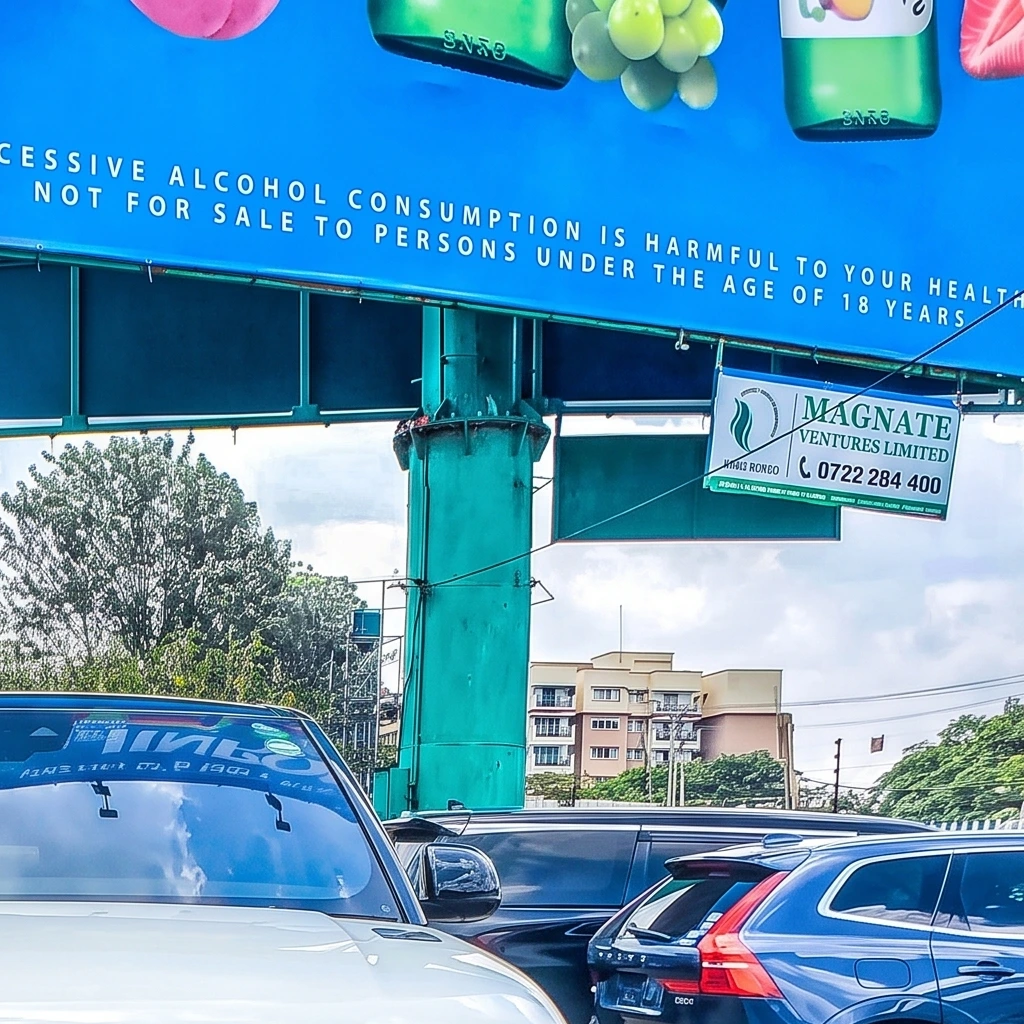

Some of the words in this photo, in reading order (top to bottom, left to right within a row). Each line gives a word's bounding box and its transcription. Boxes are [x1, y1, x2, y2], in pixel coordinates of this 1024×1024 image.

[169, 165, 326, 205] ALCOHOL
[348, 189, 580, 241] CONSUMPTION
[601, 225, 625, 248] IS
[646, 232, 779, 271] HARMFUL
[796, 256, 827, 279] TO
[844, 264, 911, 292] YOUR
[34, 180, 102, 209] NOT
[127, 191, 190, 220] FOR
[214, 203, 293, 232] SALE
[315, 215, 352, 239] TO
[375, 223, 516, 262] PERSONS
[537, 246, 635, 279] UNDER
[653, 263, 704, 289] THE
[723, 274, 774, 300] AGE
[792, 285, 823, 306] OF
[842, 293, 869, 314] 18
[886, 299, 964, 328] YEARS
[802, 395, 952, 441] MAGNATE
[799, 428, 881, 454] VENTURES
[883, 440, 950, 463] LIMITED
[817, 461, 864, 485] 0722
[867, 468, 902, 490] 284
[907, 474, 942, 495] 400
